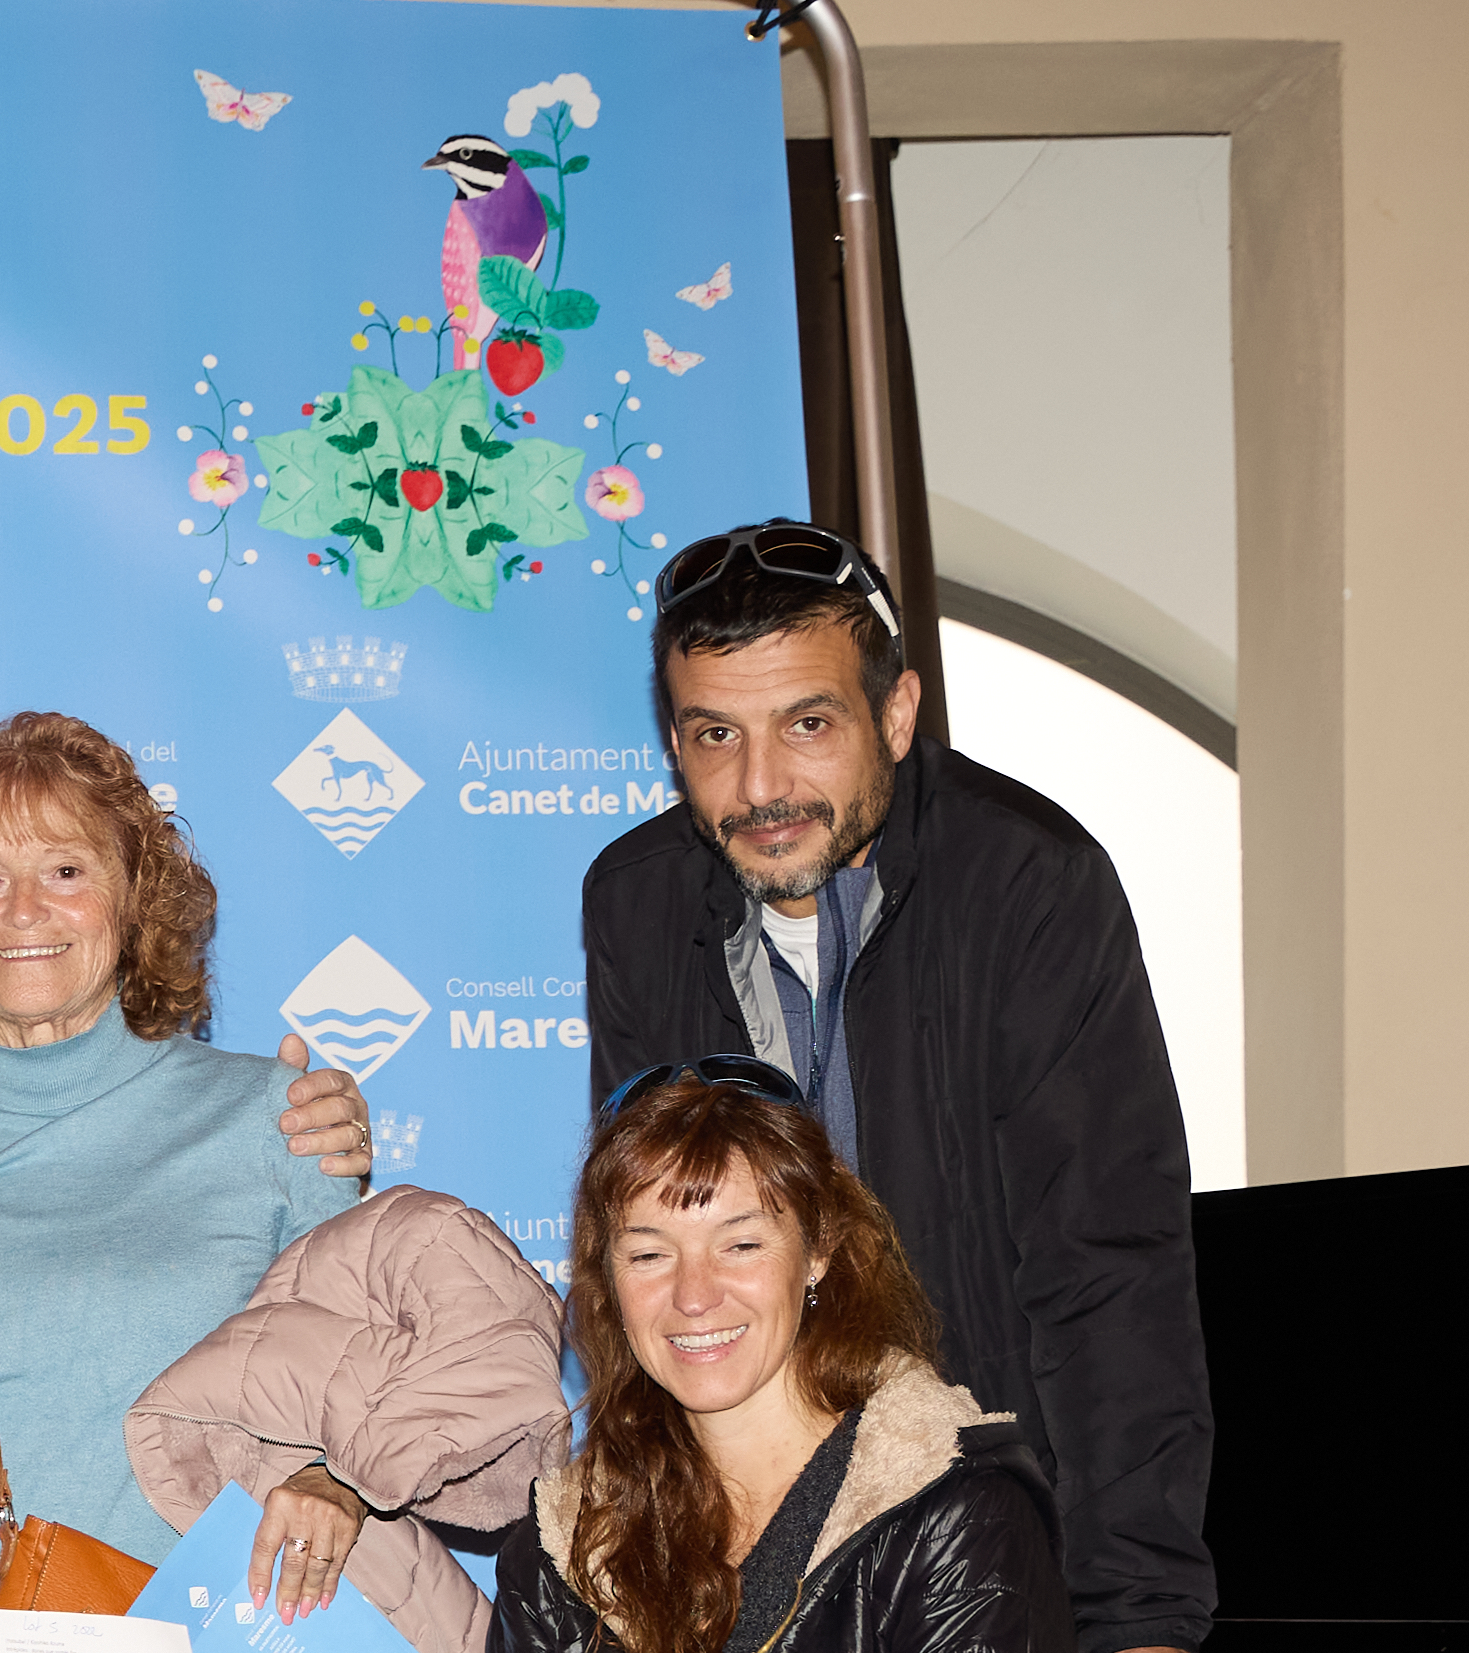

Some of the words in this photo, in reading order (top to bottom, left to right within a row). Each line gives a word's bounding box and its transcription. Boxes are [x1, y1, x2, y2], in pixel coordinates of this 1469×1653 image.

[140, 741, 178, 763] del
[458, 740, 656, 779] Ajuntament
[459, 781, 574, 816] Canet
[579, 785, 621, 816] de
[445, 975, 537, 999] Consell
[248, 1614, 276, 1647] Maresme
